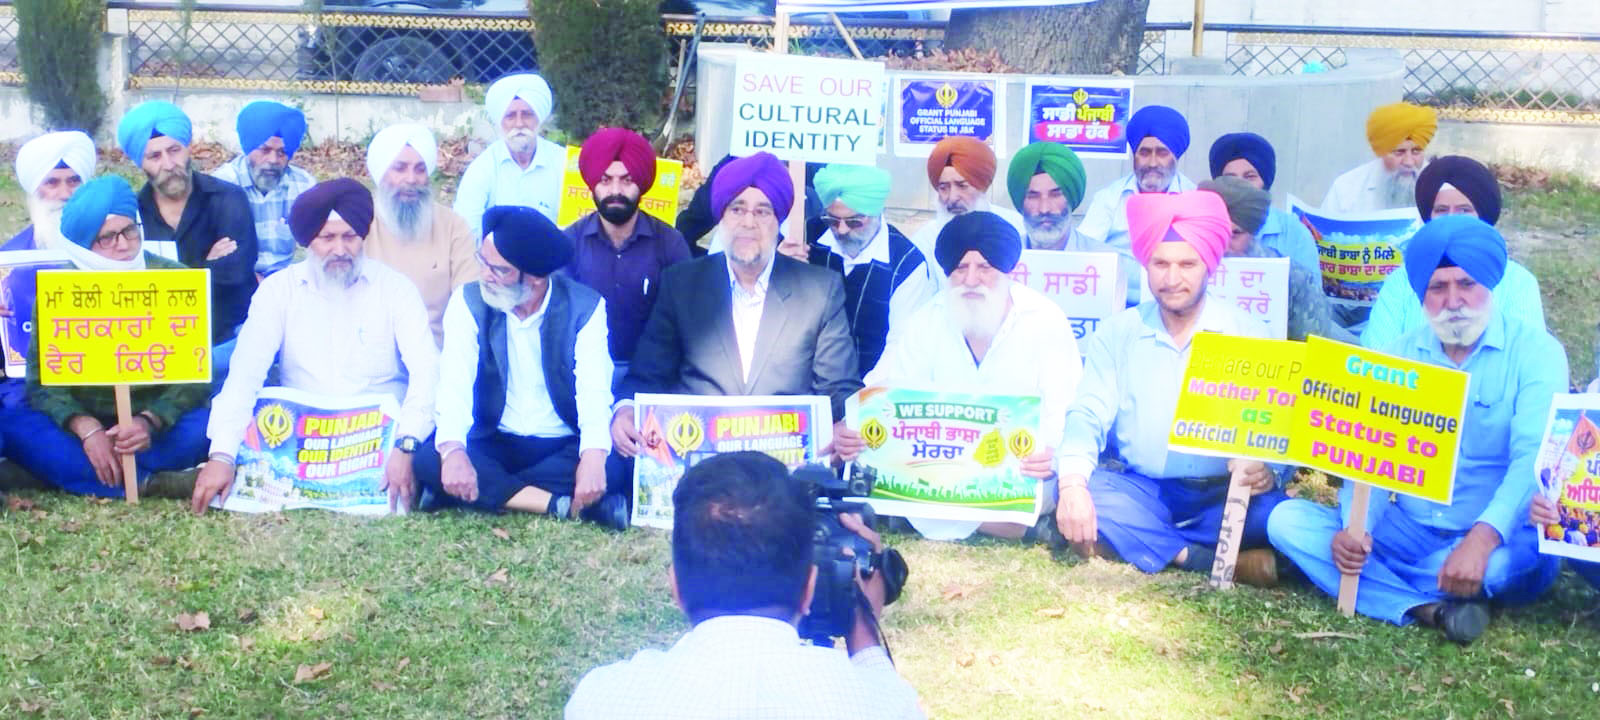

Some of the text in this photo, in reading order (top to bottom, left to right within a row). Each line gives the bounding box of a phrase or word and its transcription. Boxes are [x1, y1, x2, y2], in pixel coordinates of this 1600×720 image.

[743, 73, 872, 97] SAVE OUR
[739, 103, 876, 126] CULTURAL
[910, 117, 985, 126] OFFICIAL LANGUAGE
[945, 109, 978, 117] PUNJABI
[1077, 104, 1115, 122] ਪੰਜਾਬੀ
[745, 130, 861, 152] IDENTITY
[919, 125, 947, 133] STATUS
[1043, 264, 1101, 296] ਸਾਡੀ
[1240, 271, 1266, 288] ਦਾ
[45, 282, 198, 309] ਮਾਂ ਬੋਲੀ ਪੰਜਾਬੀ ਨਾਲ
[51, 311, 199, 339] ਸਰਕਾਰਾਂ ਦਾ
[45, 342, 206, 379] ਵੈਰ ਕਿਉਂ ?
[1256, 362, 1284, 381] our
[1345, 355, 1420, 390] Grant
[1188, 378, 1261, 402] Mother
[899, 403, 996, 422] WE SUPPORT
[1241, 408, 1273, 425] as
[1301, 378, 1458, 435] Official Language
[303, 411, 382, 437] PUNJABI
[717, 413, 800, 438] PUNJABI
[892, 421, 981, 443] ਪੰਜਾਬੀ ਭਾਸ਼ਾ
[1308, 409, 1439, 459] Status to
[303, 427, 383, 450] OUR LANGUAGE
[717, 435, 803, 452] OUR LANGUAGE
[1175, 420, 1290, 455] Official Lang
[298, 437, 383, 463] OUR IDENTITY
[912, 440, 965, 460] ਮੋਰਚਾ
[305, 452, 380, 478] OUR RIGHT!
[1311, 440, 1426, 487] PUNJABI
